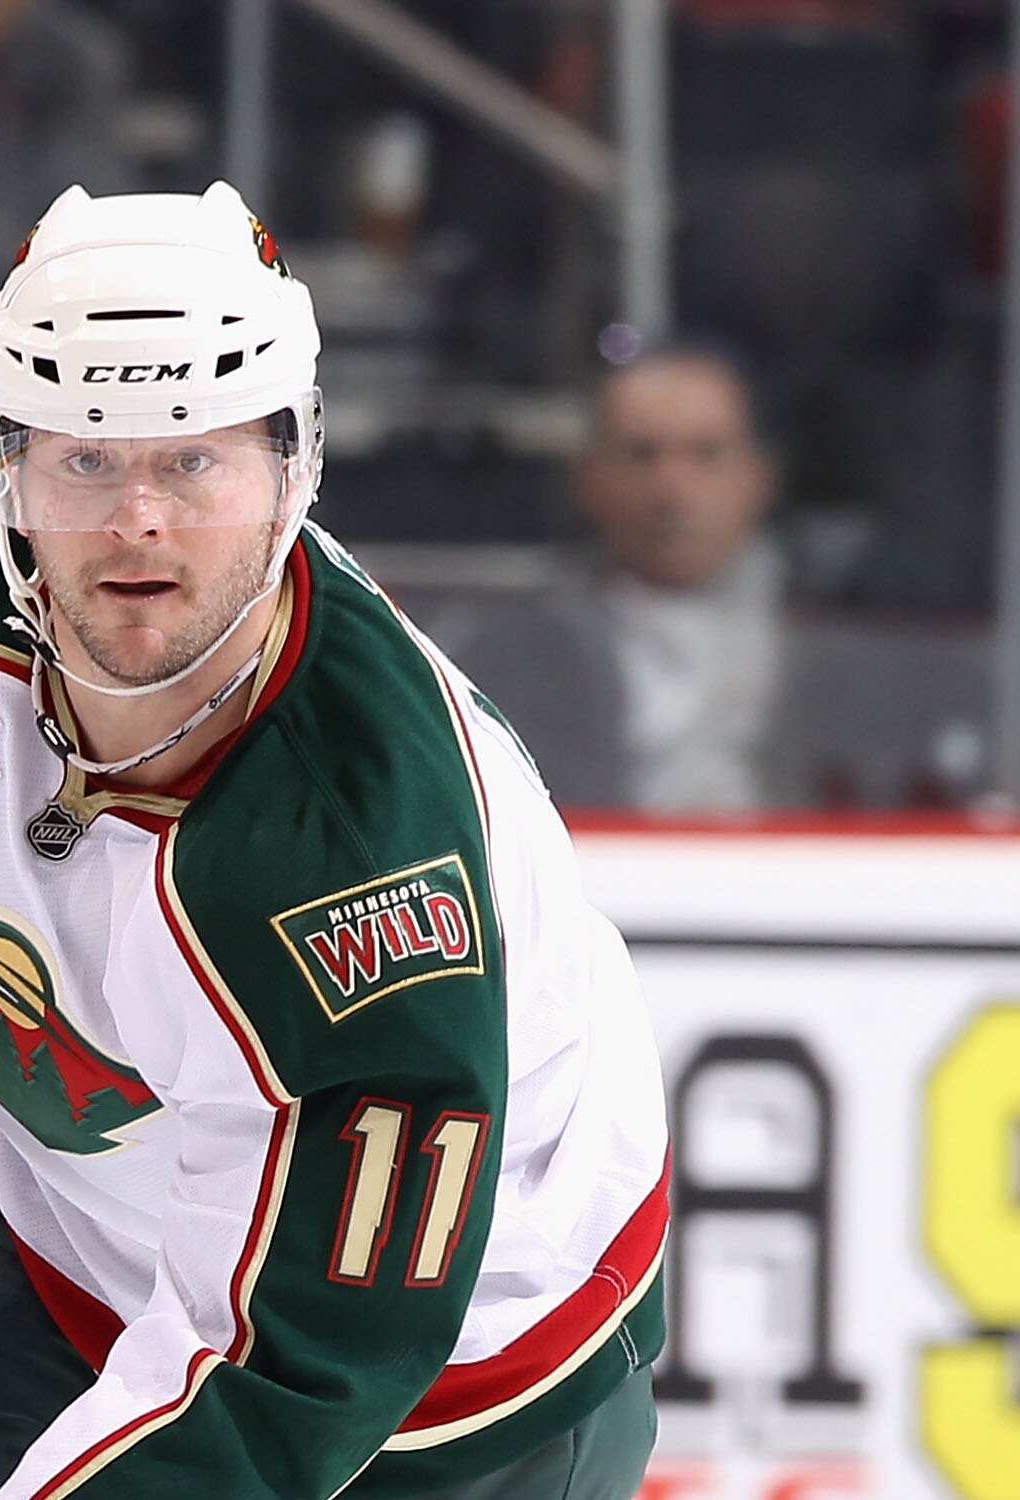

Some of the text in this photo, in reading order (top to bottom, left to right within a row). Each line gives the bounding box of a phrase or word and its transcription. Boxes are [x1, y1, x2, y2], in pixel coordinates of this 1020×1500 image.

[82, 362, 190, 384] CCM
[33, 823, 75, 843] NHL
[327, 878, 431, 926] MINNESOTA
[304, 891, 471, 998] WILD
[327, 1094, 493, 1288] 11
